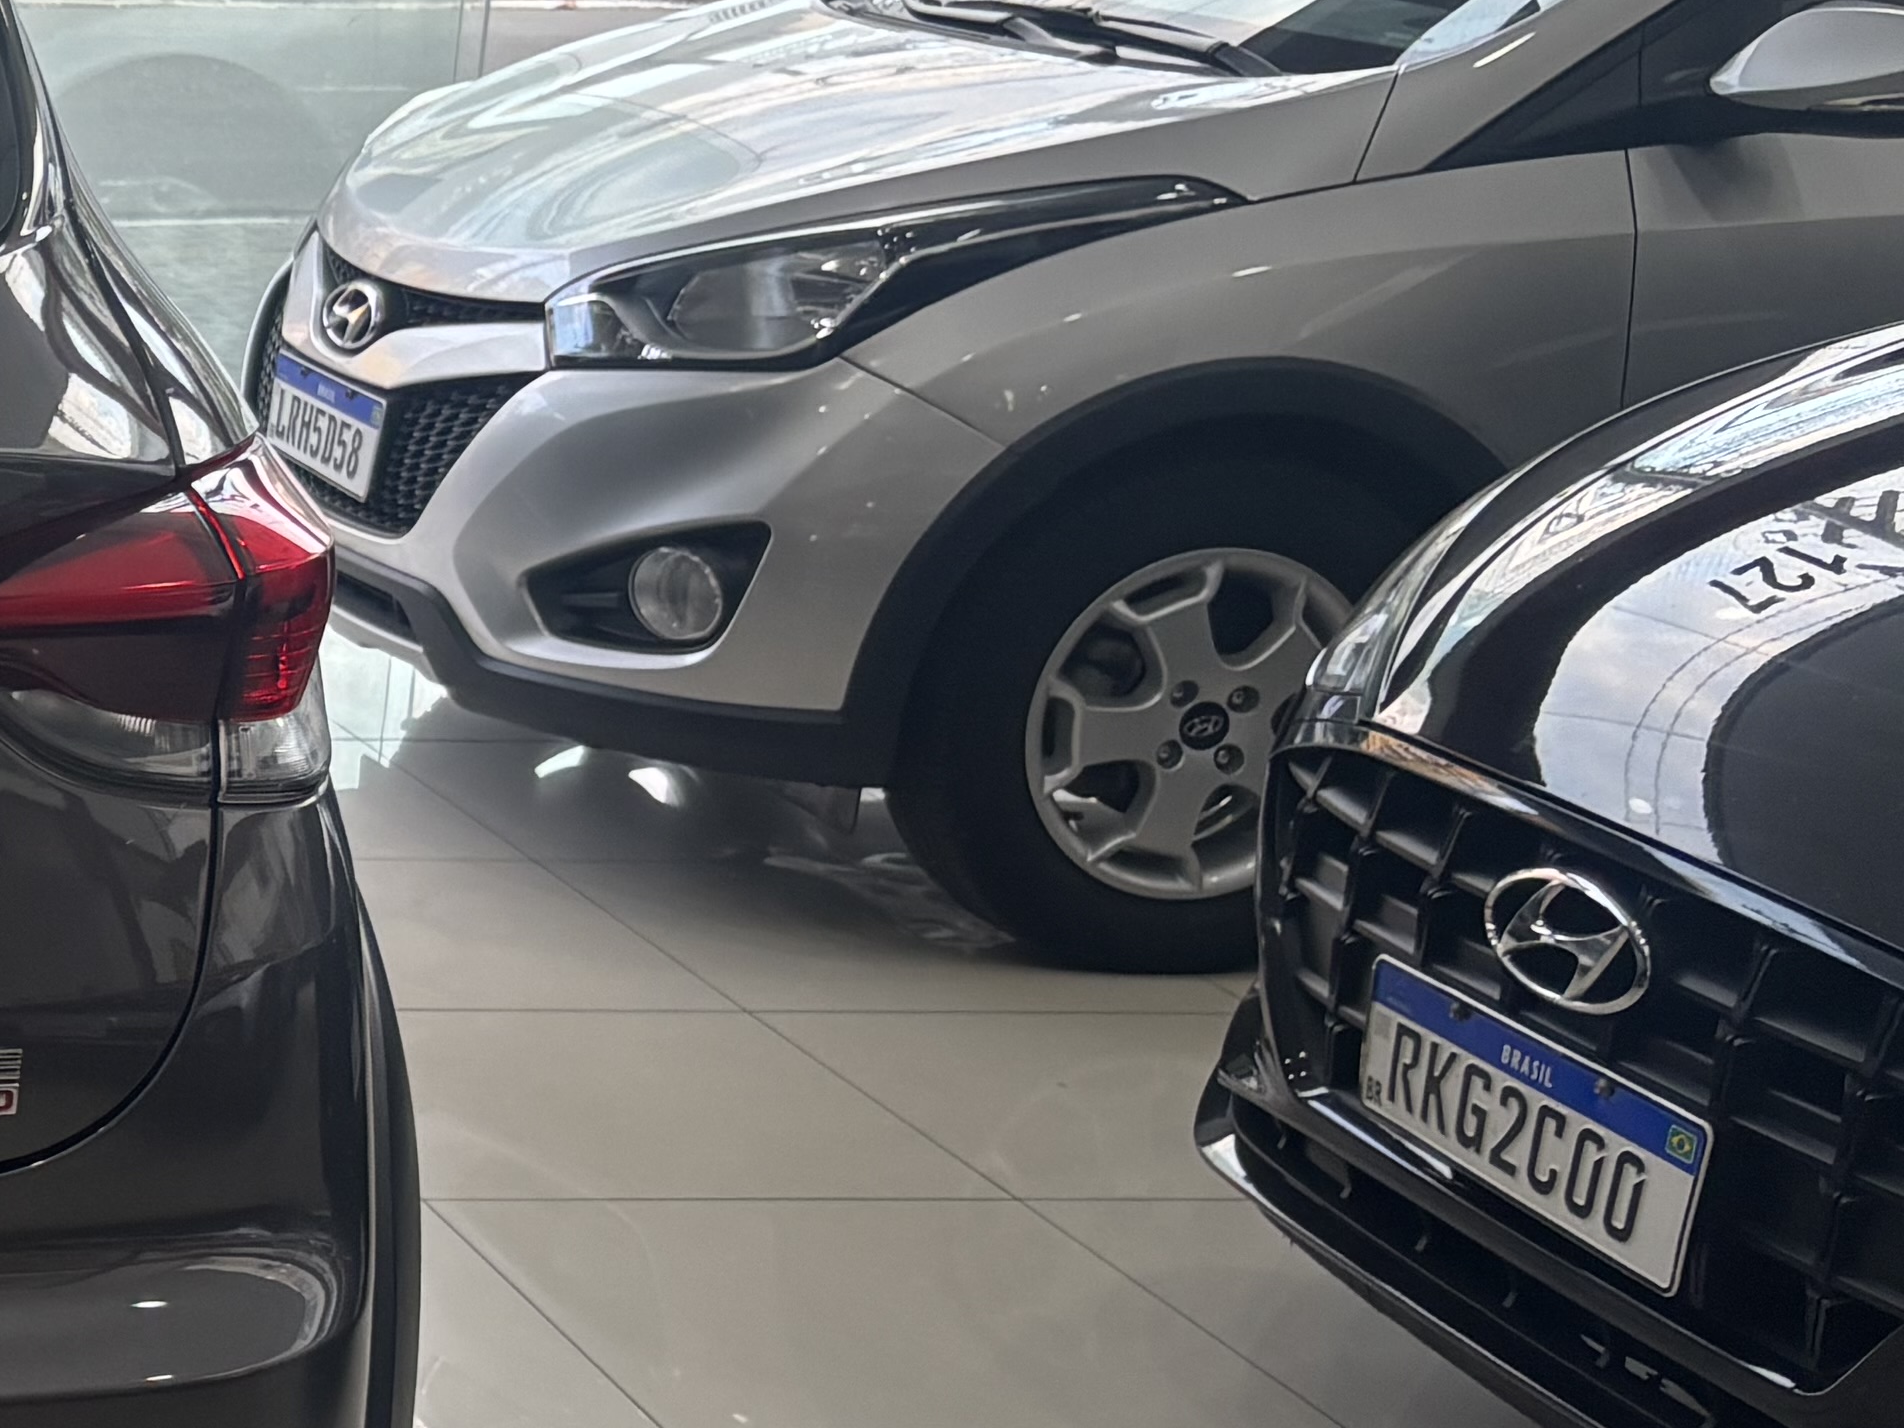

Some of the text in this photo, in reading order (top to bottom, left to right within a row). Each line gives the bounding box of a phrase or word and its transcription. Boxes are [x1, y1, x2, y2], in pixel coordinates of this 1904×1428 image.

[275, 388, 364, 480] LRH5D58
[1501, 1043, 1553, 1089] BRASIL
[1388, 1021, 1650, 1245] RKG2C00
